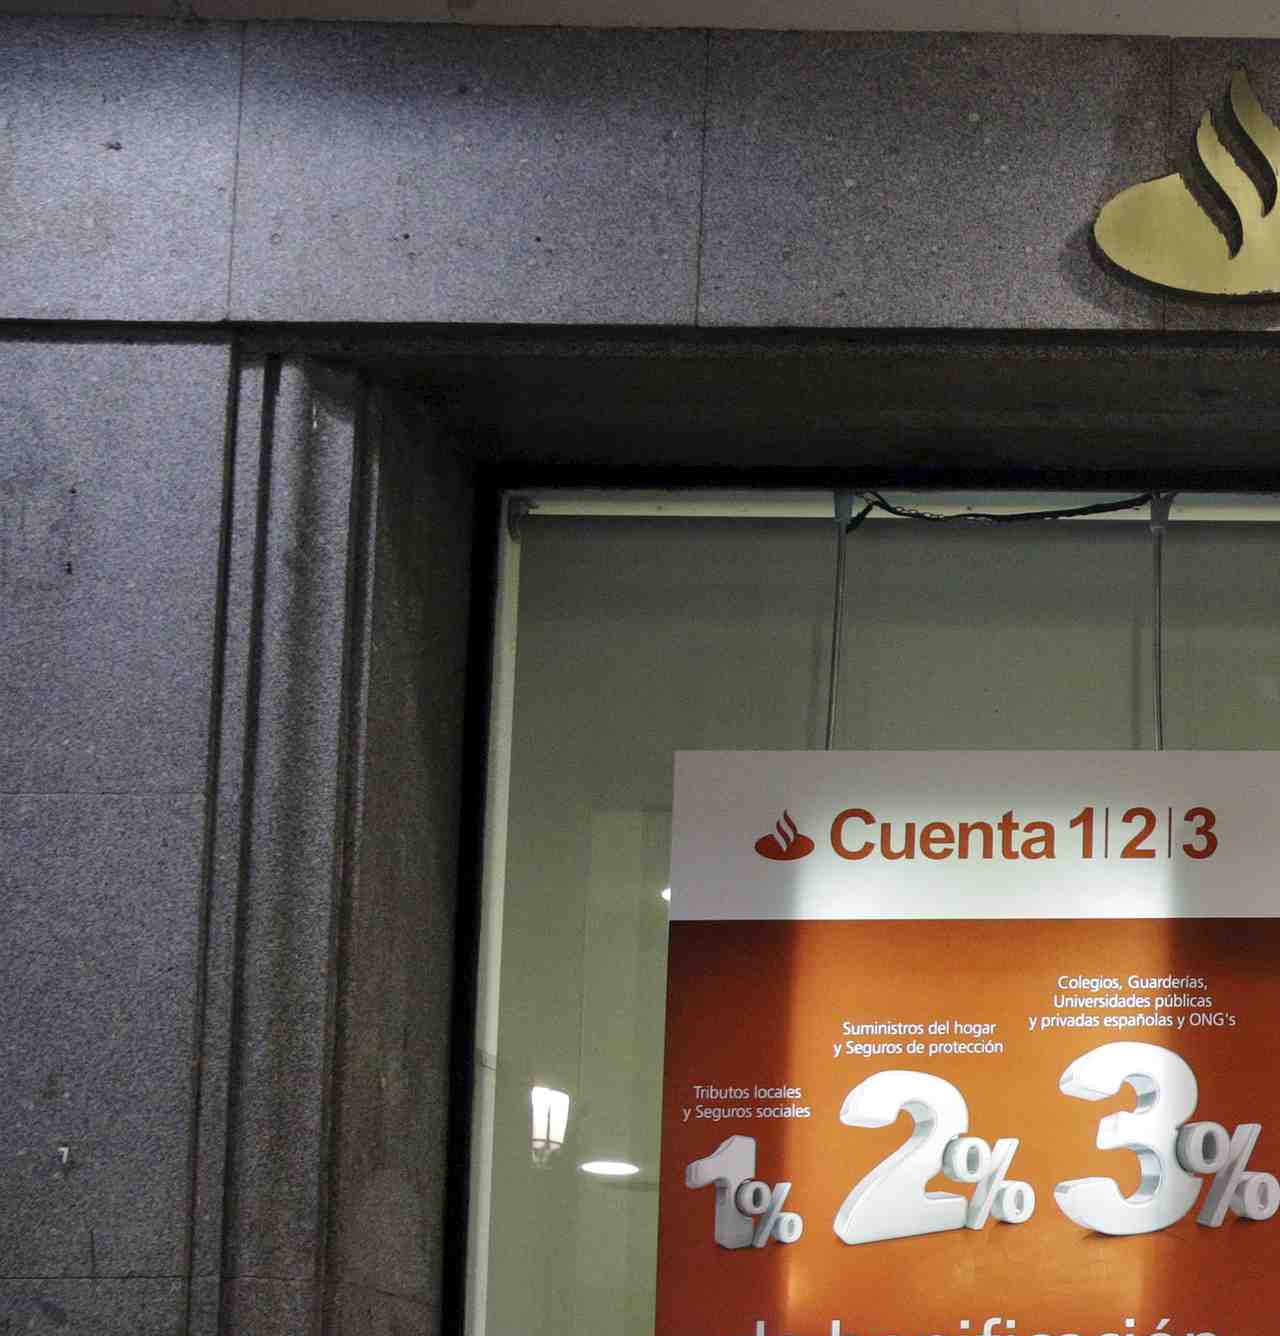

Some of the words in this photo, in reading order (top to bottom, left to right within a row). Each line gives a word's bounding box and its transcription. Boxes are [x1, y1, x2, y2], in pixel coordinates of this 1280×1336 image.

[830, 807, 1056, 860] Cuenta
[1057, 975, 1123, 991] Colegios,
[1054, 993, 1151, 1008] Universidades
[1155, 993, 1213, 1010] públicas
[842, 1021, 924, 1036] Suministros
[928, 1020, 949, 1035] del
[954, 1020, 997, 1037] hogar
[1028, 1015, 1038, 1030] y
[1040, 1013, 1100, 1030] privadas
[1103, 1012, 1173, 1029] españolas
[1177, 1015, 1185, 1029] y
[833, 1042, 842, 1057] y
[846, 1040, 903, 1057] Seguros
[908, 1040, 925, 1054] de
[928, 1040, 1004, 1056] protección
[693, 1084, 750, 1100] Tributos
[754, 1084, 802, 1099] locales
[682, 1107, 692, 1122] y
[695, 1104, 753, 1121] Seguros
[756, 1103, 811, 1118] sociales
[1053, 1041, 1280, 1236] 3%
[832, 1069, 1036, 1245] 2%
[685, 1134, 804, 1249] 1%
